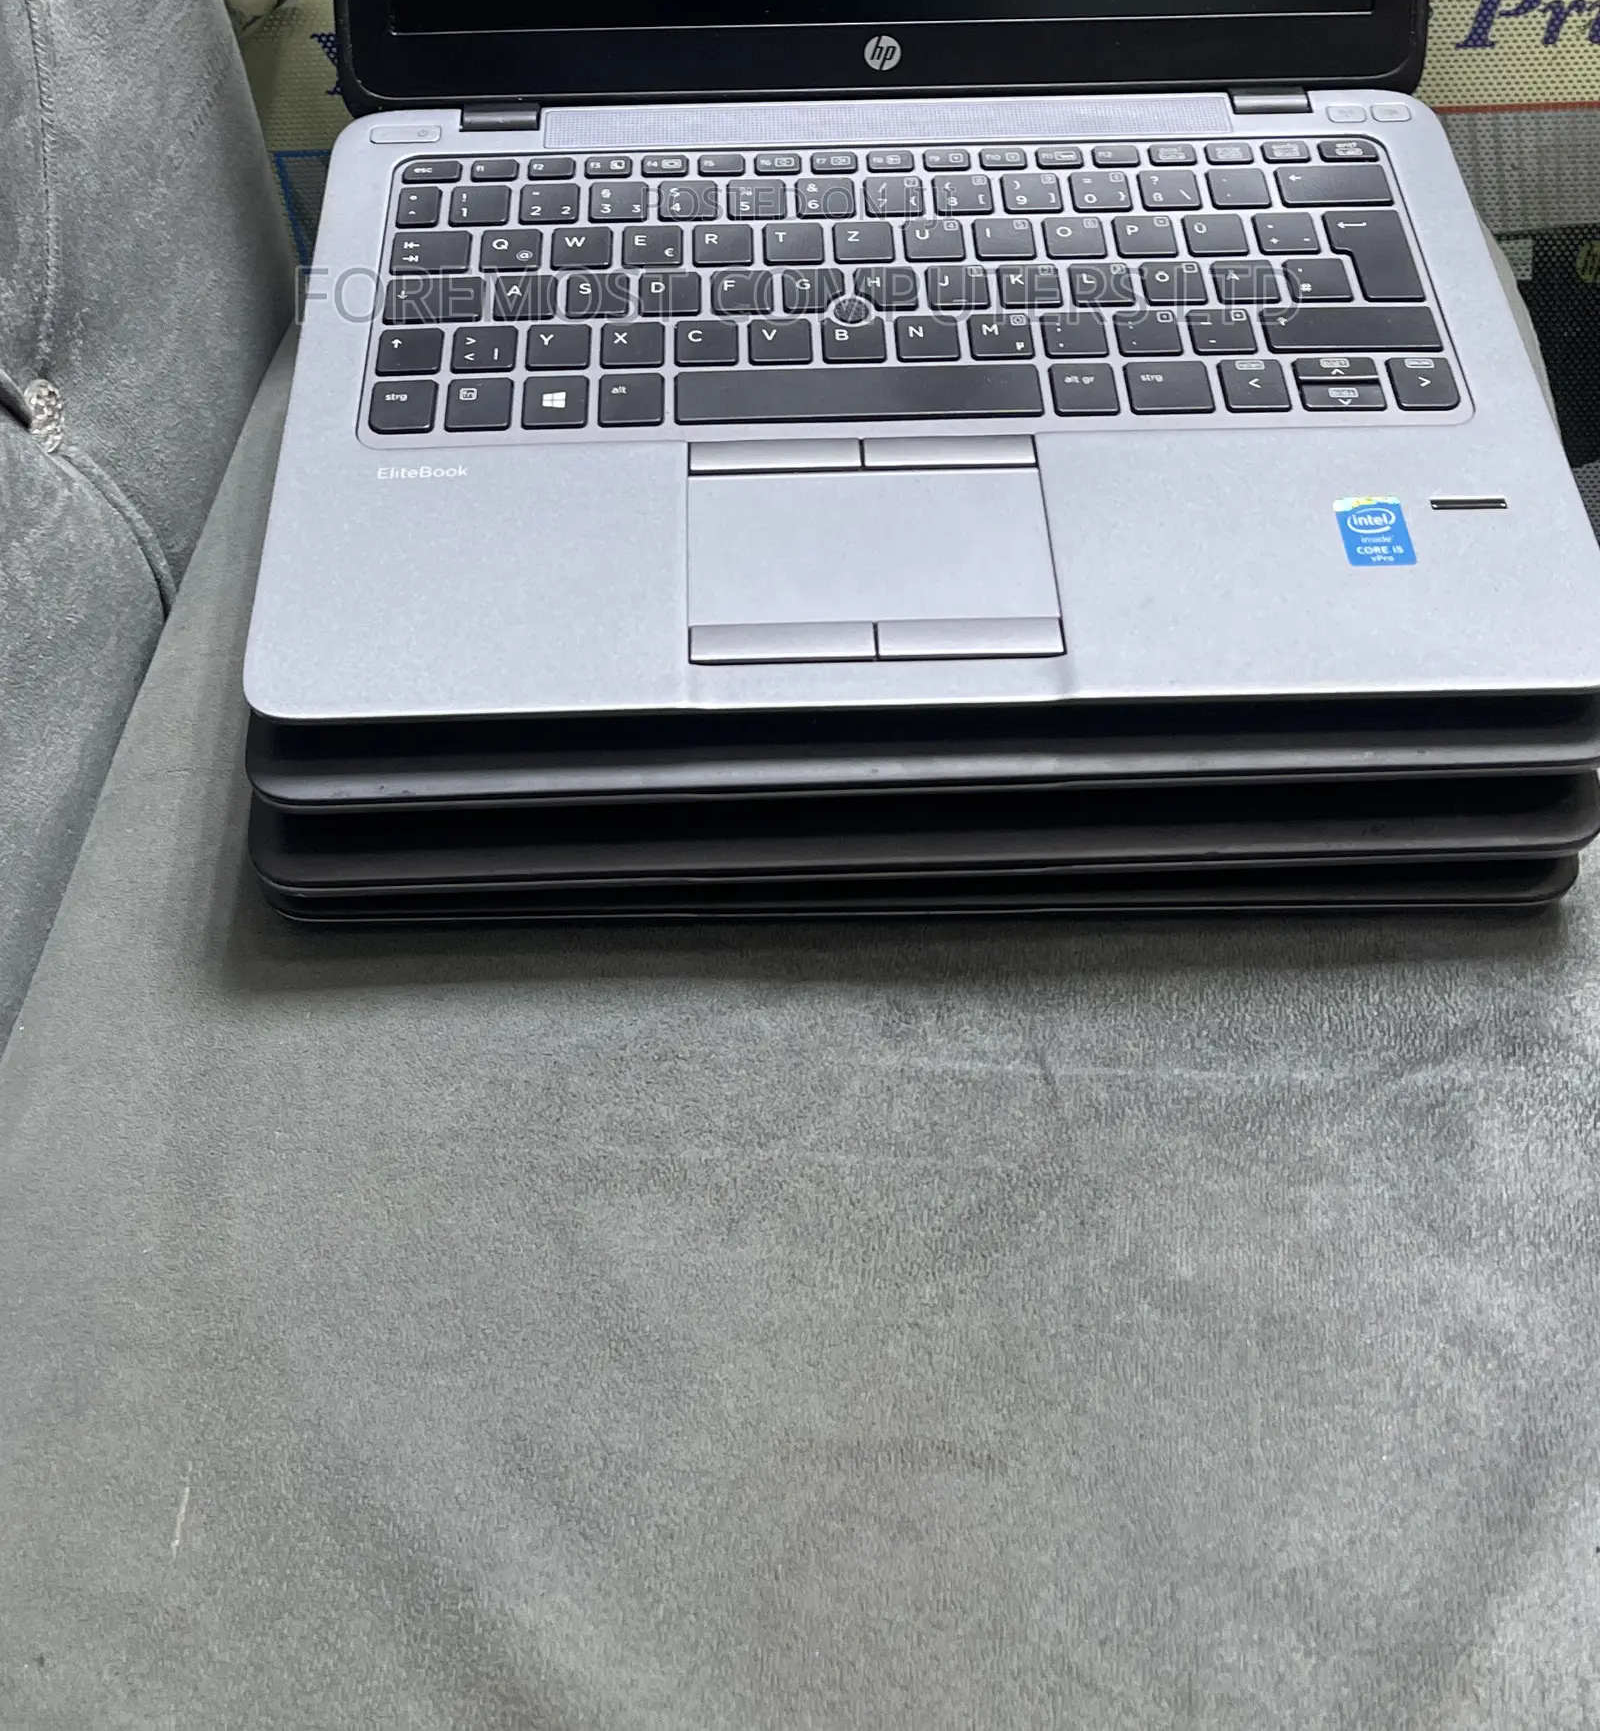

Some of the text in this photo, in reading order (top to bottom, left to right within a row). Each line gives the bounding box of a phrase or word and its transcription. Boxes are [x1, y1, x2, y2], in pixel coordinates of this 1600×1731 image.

[864, 35, 902, 71] hp
[739, 200, 751, 211] 5
[807, 199, 820, 210] 6
[1015, 195, 1028, 206] 9
[461, 207, 468, 218] 1
[529, 205, 542, 216] 2
[599, 203, 612, 214] 3
[669, 201, 682, 213] 4
[847, 230, 860, 242] Z
[915, 228, 930, 240] U
[984, 227, 992, 238] I
[1056, 226, 1073, 238] O
[1126, 224, 1140, 236] P
[564, 236, 587, 248] W
[634, 234, 648, 247] E
[704, 232, 719, 245] R
[774, 231, 788, 243] T
[492, 238, 509, 251] Q
[515, 250, 533, 262] @
[664, 247, 675, 258] €
[795, 278, 812, 291] G
[866, 276, 882, 288] H
[938, 275, 950, 287] J
[1009, 273, 1025, 286] K
[1082, 272, 1096, 285] L
[506, 284, 523, 297] A
[578, 282, 592, 295] S
[650, 281, 666, 294] D
[723, 279, 736, 292] F
[761, 328, 778, 341] V
[834, 329, 850, 342] B
[908, 325, 924, 338] N
[981, 323, 1000, 336] M
[539, 333, 555, 346] Y
[613, 332, 628, 345] X
[687, 329, 703, 343] C
[1064, 374, 1079, 384] alt
[1140, 373, 1164, 384] strg
[611, 385, 628, 395] alt
[384, 392, 408, 402] strg
[376, 465, 469, 480] EliteBook
[1351, 512, 1389, 526] intel
[1355, 545, 1390, 556] CORE
